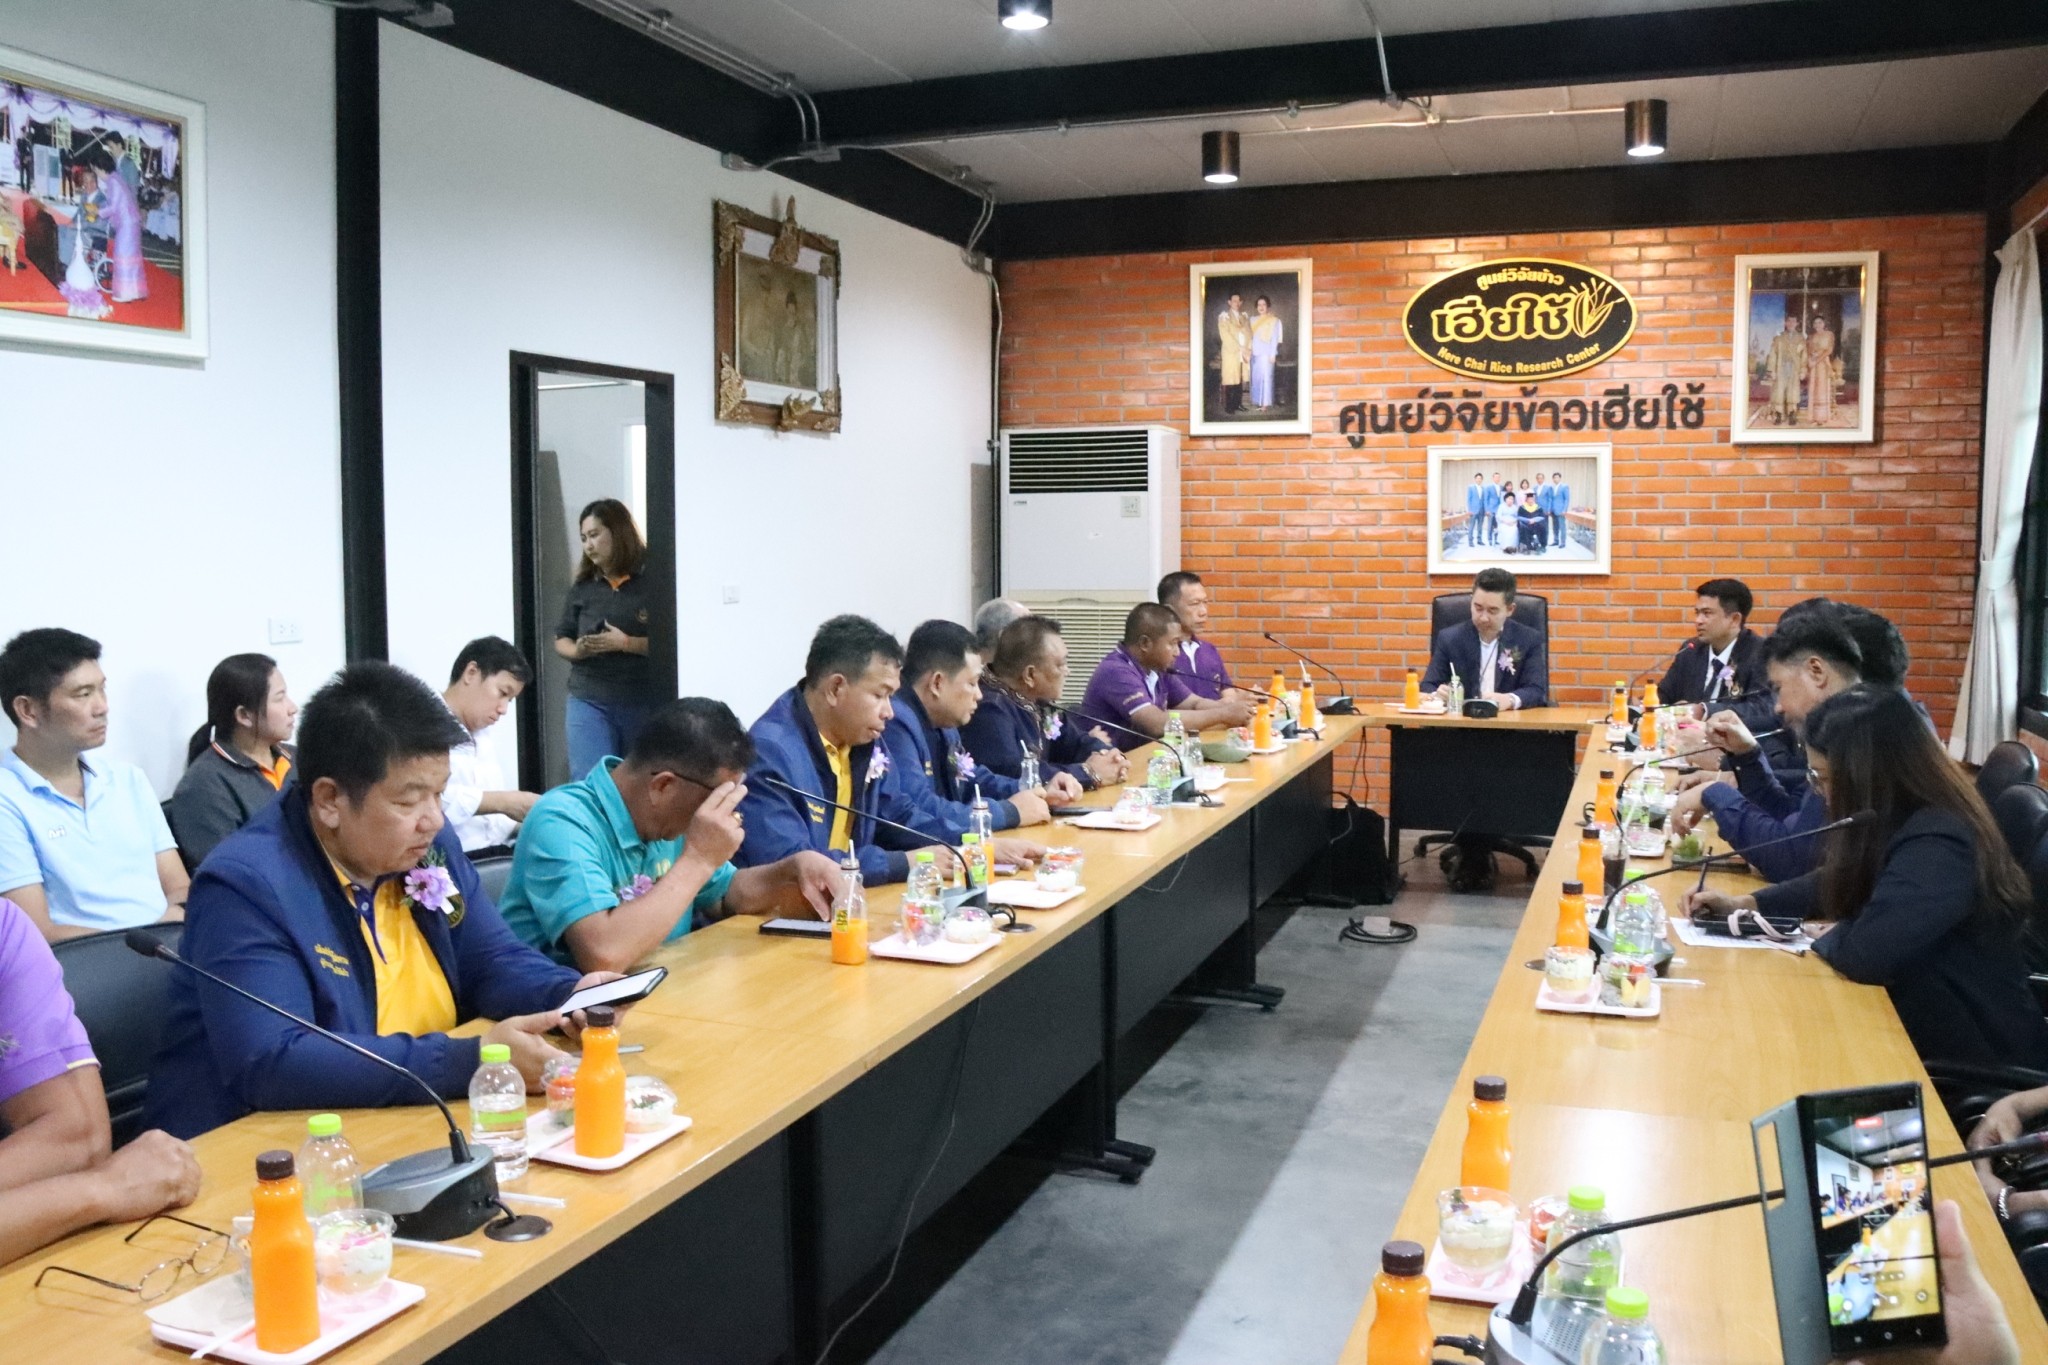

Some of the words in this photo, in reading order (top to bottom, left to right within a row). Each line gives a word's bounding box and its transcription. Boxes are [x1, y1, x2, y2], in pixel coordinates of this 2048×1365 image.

[1476, 266, 1565, 291] ศูนย์วิจัยข้าว
[1437, 346, 1462, 365] Here
[1464, 356, 1488, 371] Chai
[1489, 361, 1513, 373] Rice
[1515, 357, 1564, 374] Research
[1565, 342, 1601, 365] Center
[1339, 382, 1706, 449] ศูนย์วิจัยข้าวเฮียใช้
